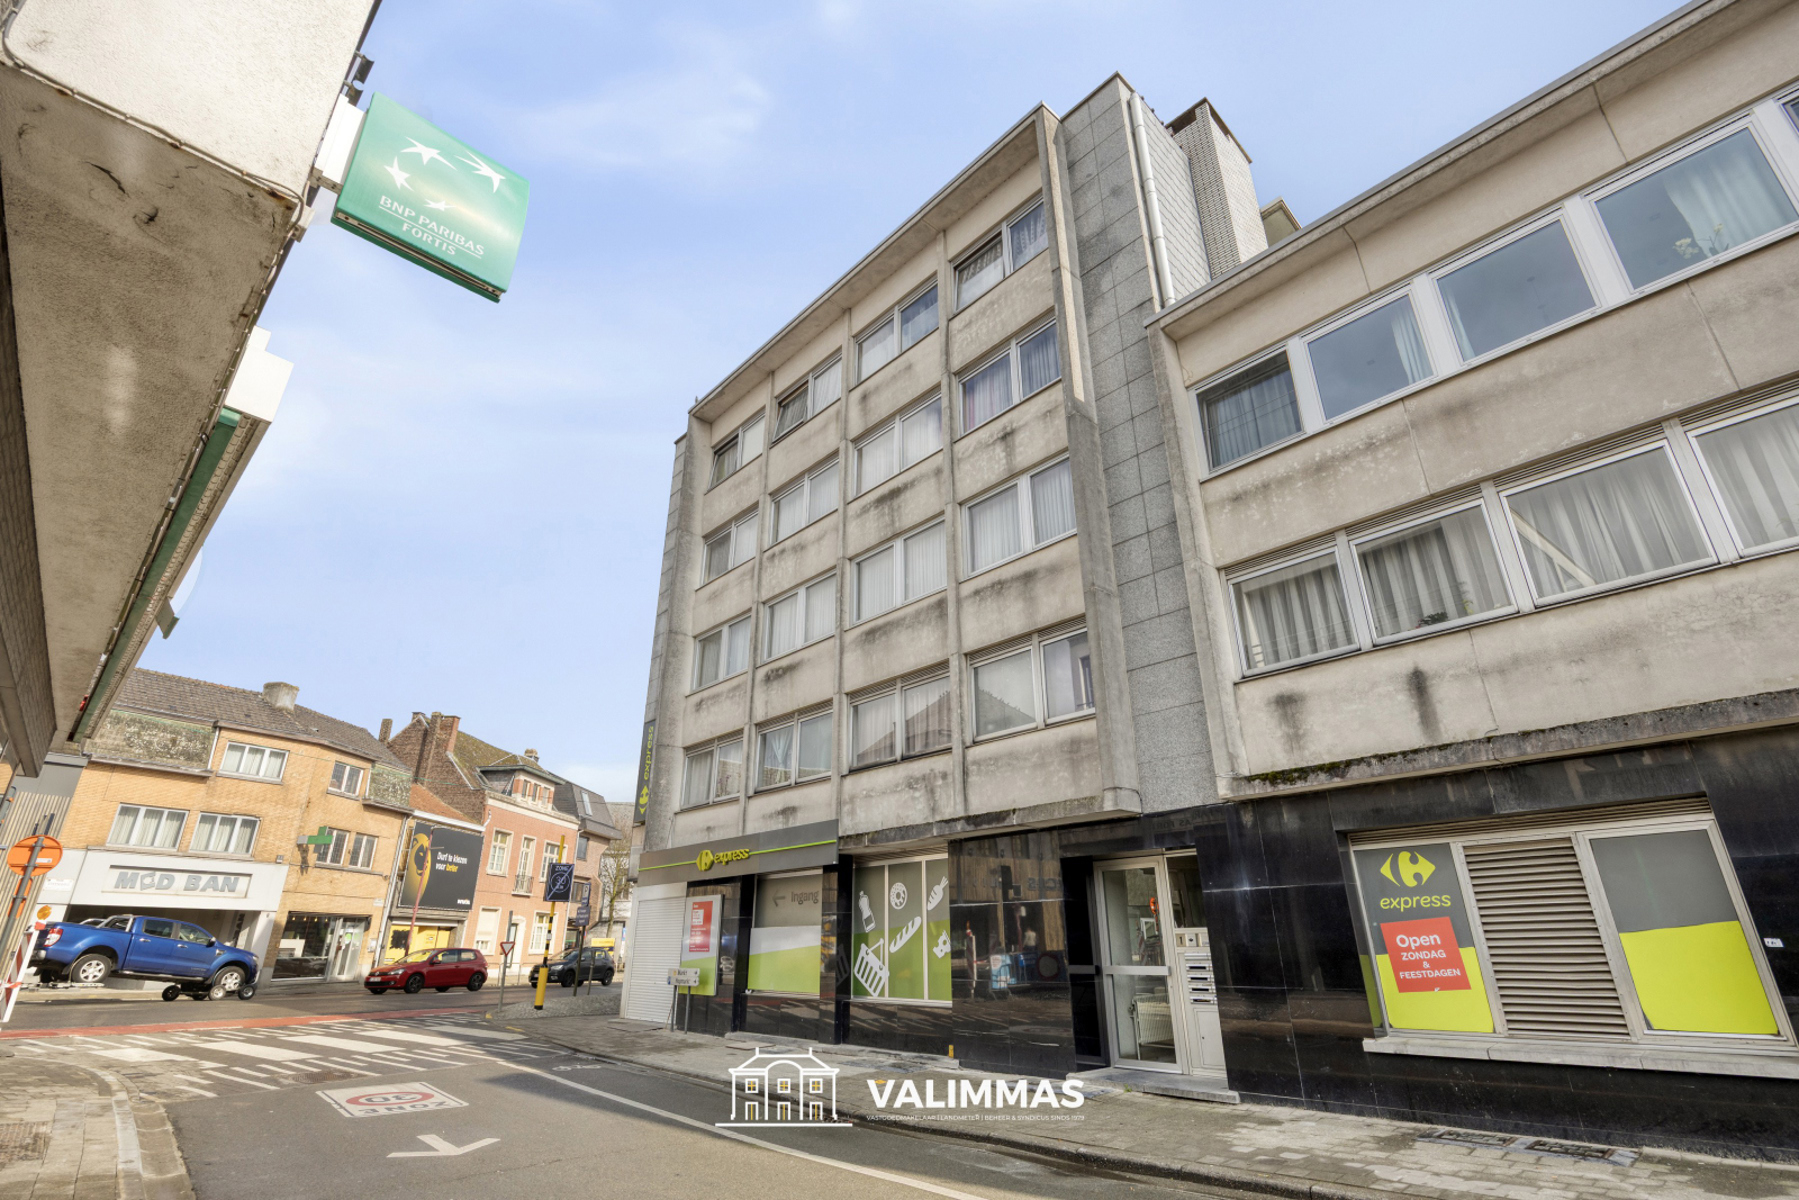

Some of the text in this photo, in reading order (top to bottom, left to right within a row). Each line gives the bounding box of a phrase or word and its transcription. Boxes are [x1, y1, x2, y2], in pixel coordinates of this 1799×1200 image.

[378, 195, 485, 255] BNP PARIBAS
[402, 223, 456, 256] FORTIS
[643, 725, 654, 781] express
[713, 848, 750, 866] express
[183, 874, 240, 892] BAN
[791, 890, 820, 905] Ingang
[1379, 893, 1452, 912] express
[1396, 934, 1441, 950] Open
[1401, 949, 1447, 961] ZONDAG
[1422, 961, 1430, 969] &
[1399, 968, 1461, 979] FEESTDAGEN
[364, 1094, 416, 1102] 30
[358, 1101, 449, 1114] ZONE
